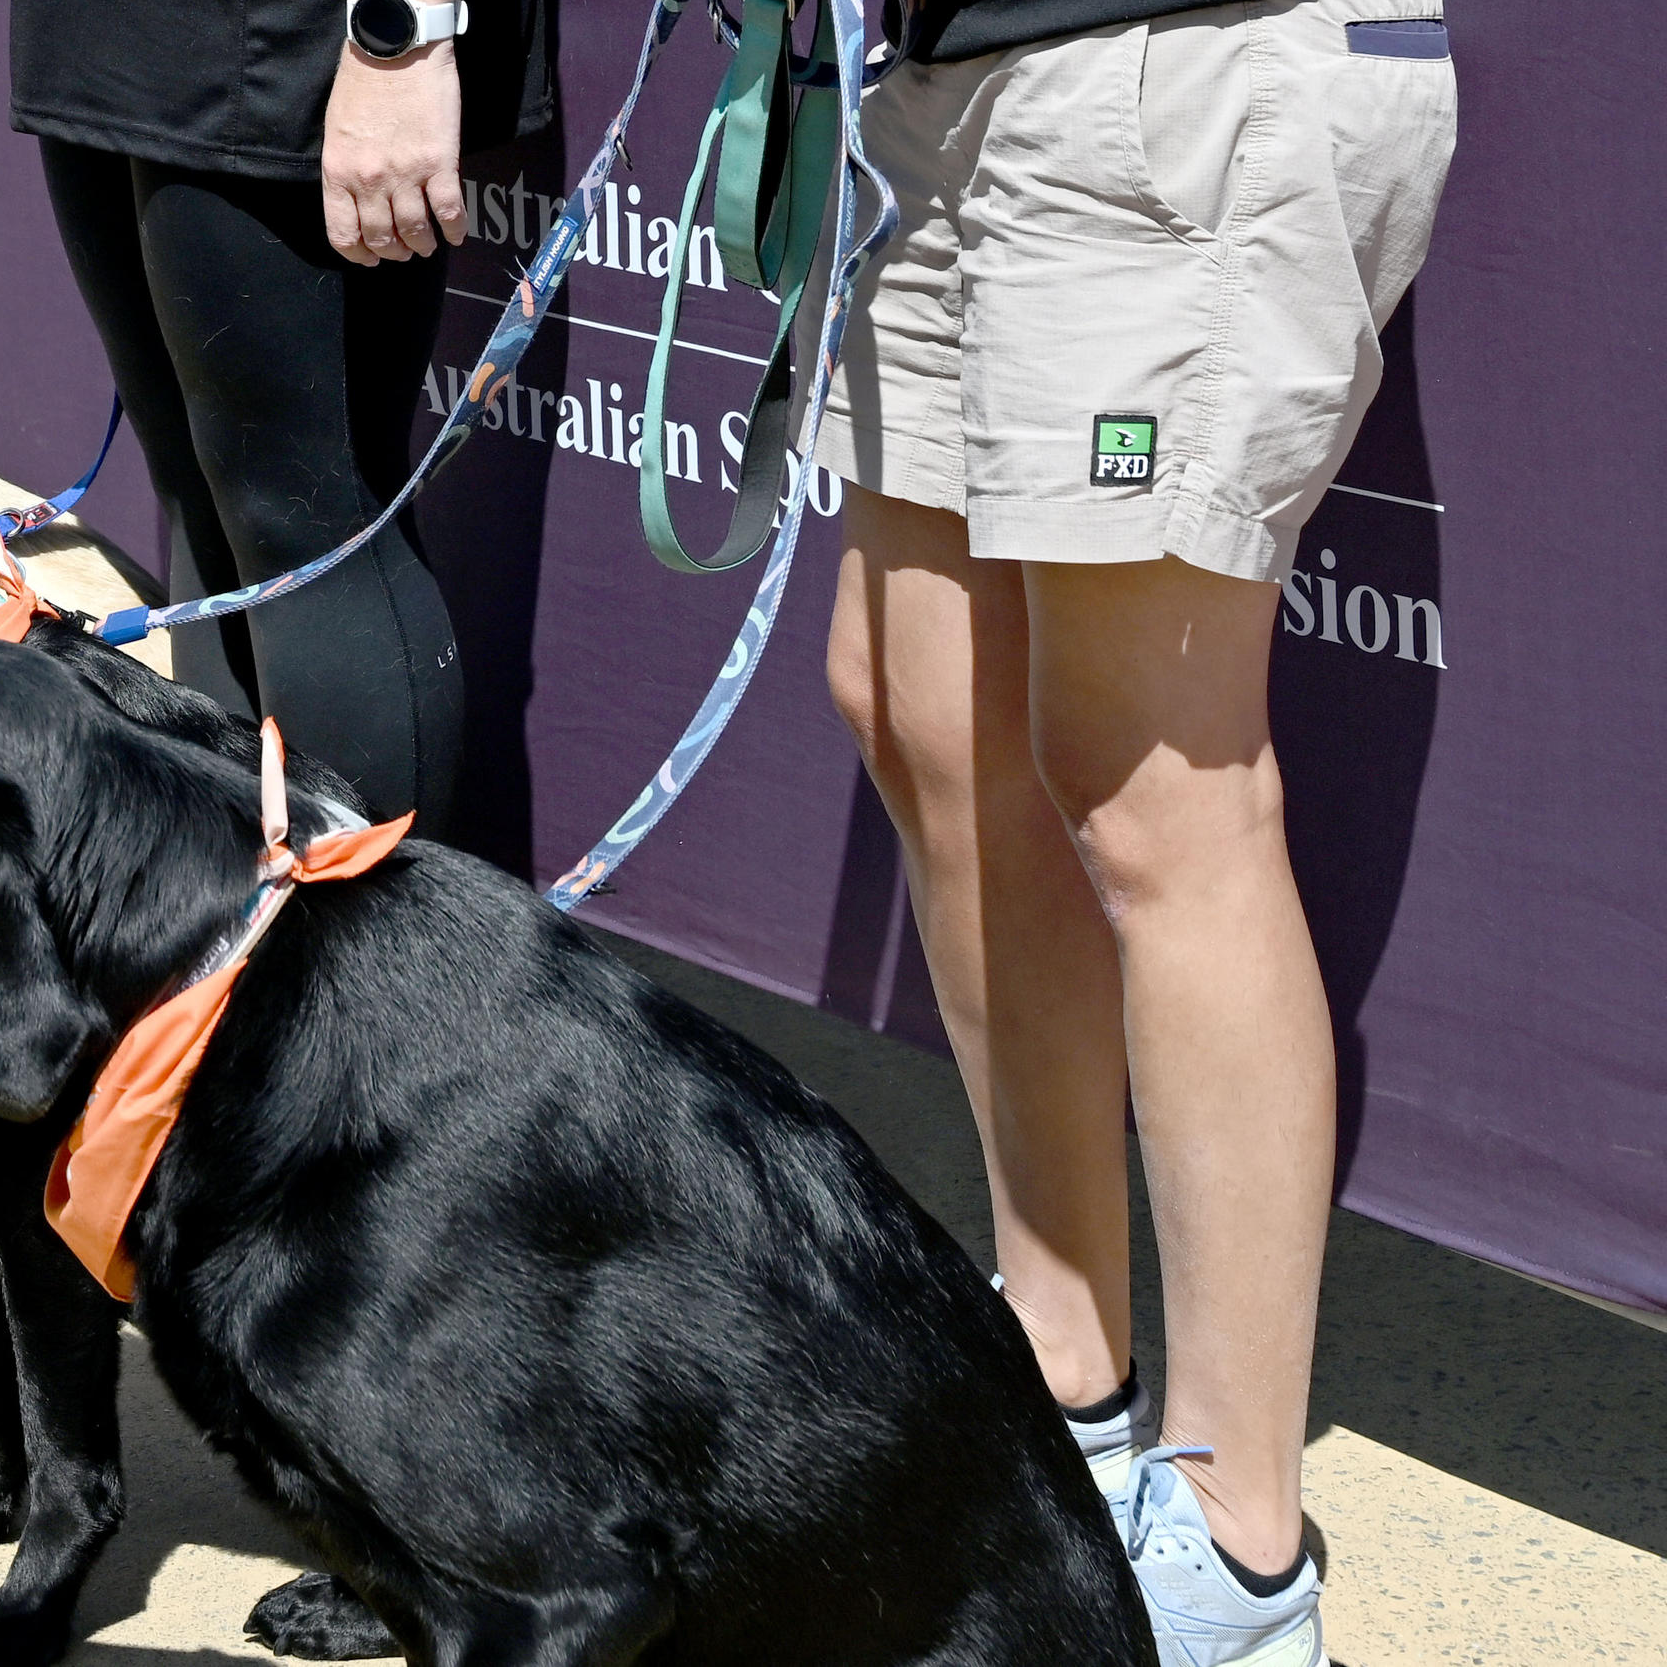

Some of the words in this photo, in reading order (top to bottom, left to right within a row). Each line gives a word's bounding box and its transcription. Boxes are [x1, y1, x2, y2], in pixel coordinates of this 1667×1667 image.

[462, 169, 729, 293] stralian
[549, 226, 569, 258] HOUND
[1283, 547, 1448, 670] sion
